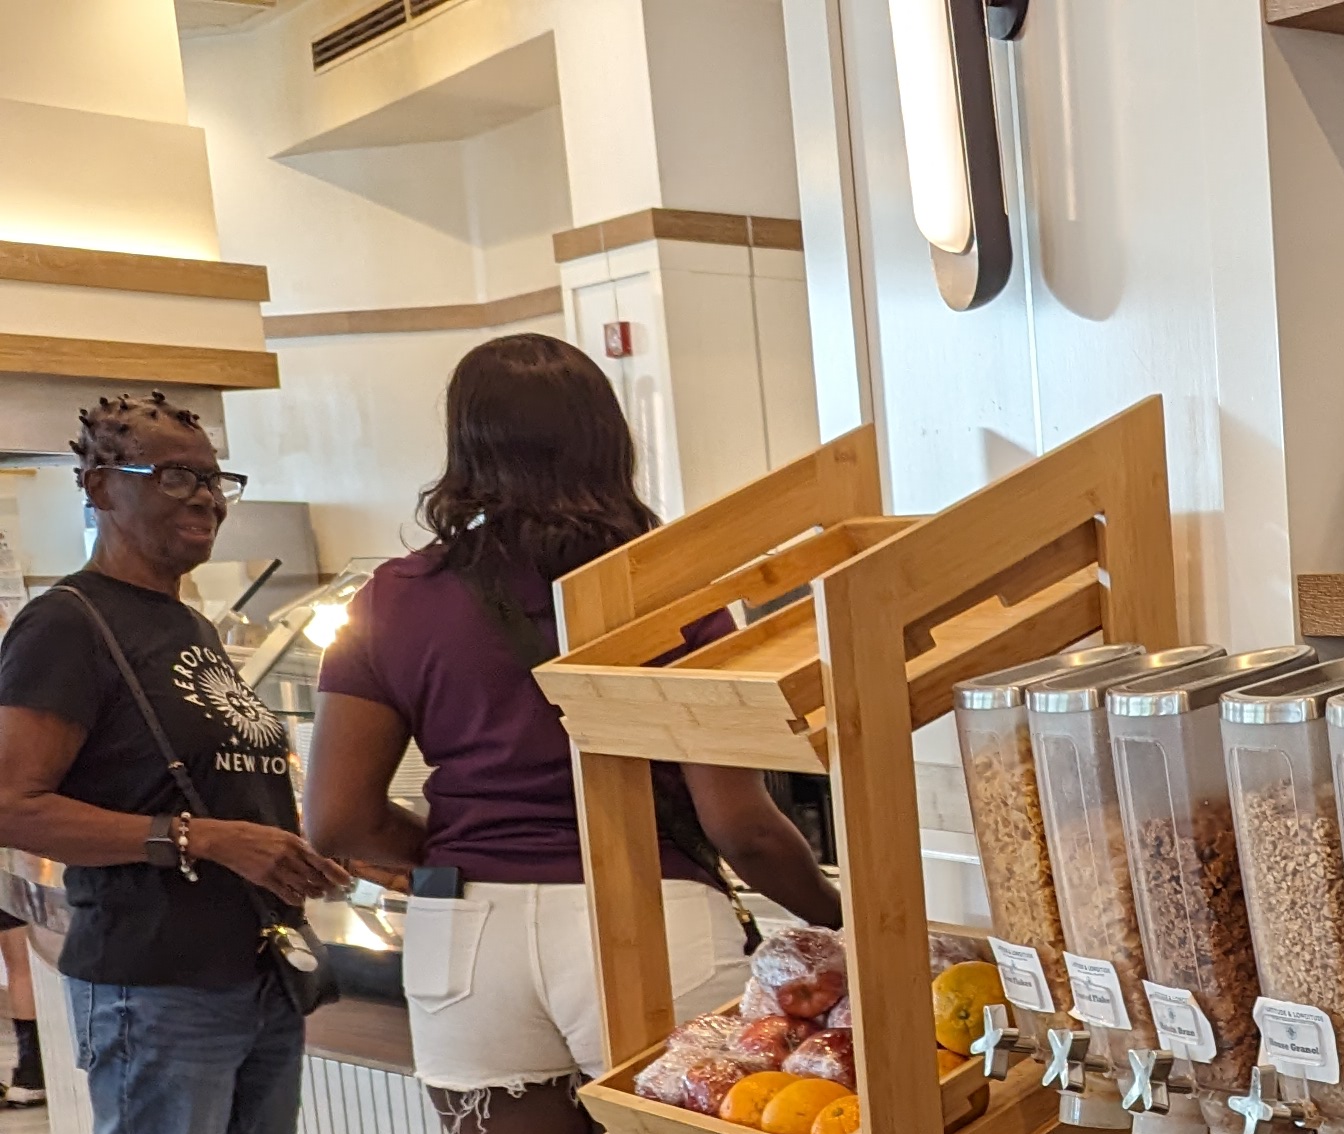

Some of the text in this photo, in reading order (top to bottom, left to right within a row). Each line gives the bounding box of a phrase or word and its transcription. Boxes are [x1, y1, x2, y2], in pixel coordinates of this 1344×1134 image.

[215, 752, 287, 775] NEW YO
[1290, 1043, 1320, 1055] Granol
